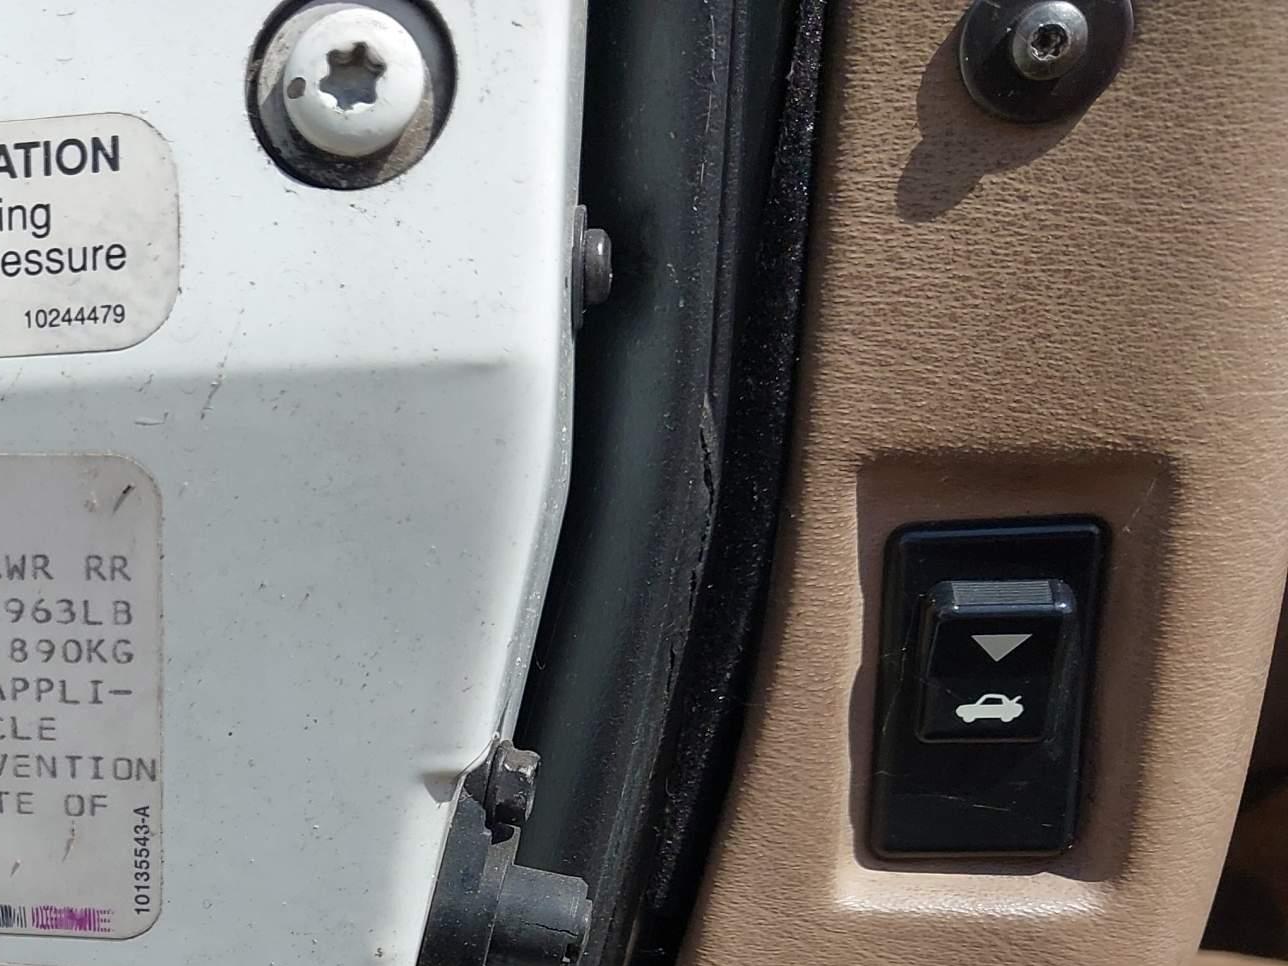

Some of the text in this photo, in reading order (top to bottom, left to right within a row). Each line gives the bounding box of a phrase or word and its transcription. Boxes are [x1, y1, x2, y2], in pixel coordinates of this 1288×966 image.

[25, 304, 125, 328] 10244479
[85, 555, 131, 581] RR
[10, 638, 134, 664] 890KG
[64, 794, 107, 816] OF
[133, 806, 150, 914] 10135543-A
